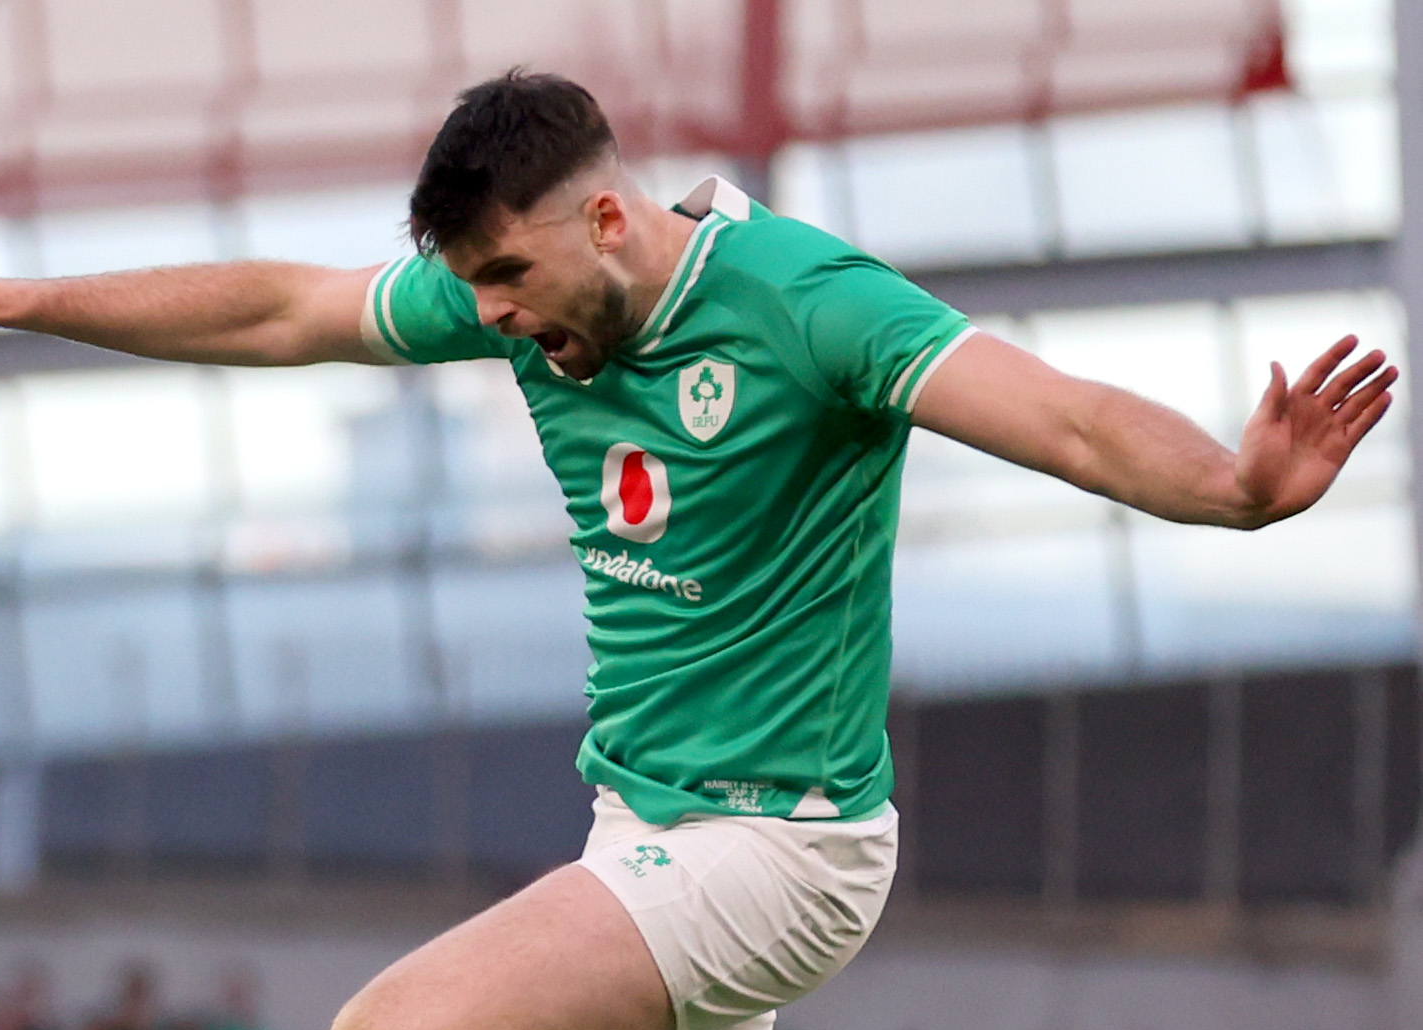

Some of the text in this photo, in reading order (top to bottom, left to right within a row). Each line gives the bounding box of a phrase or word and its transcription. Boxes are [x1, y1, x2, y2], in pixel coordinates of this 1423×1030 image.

[692, 415, 719, 428] IRFU
[583, 547, 703, 602] vodafone
[618, 857, 647, 878] IRFU
